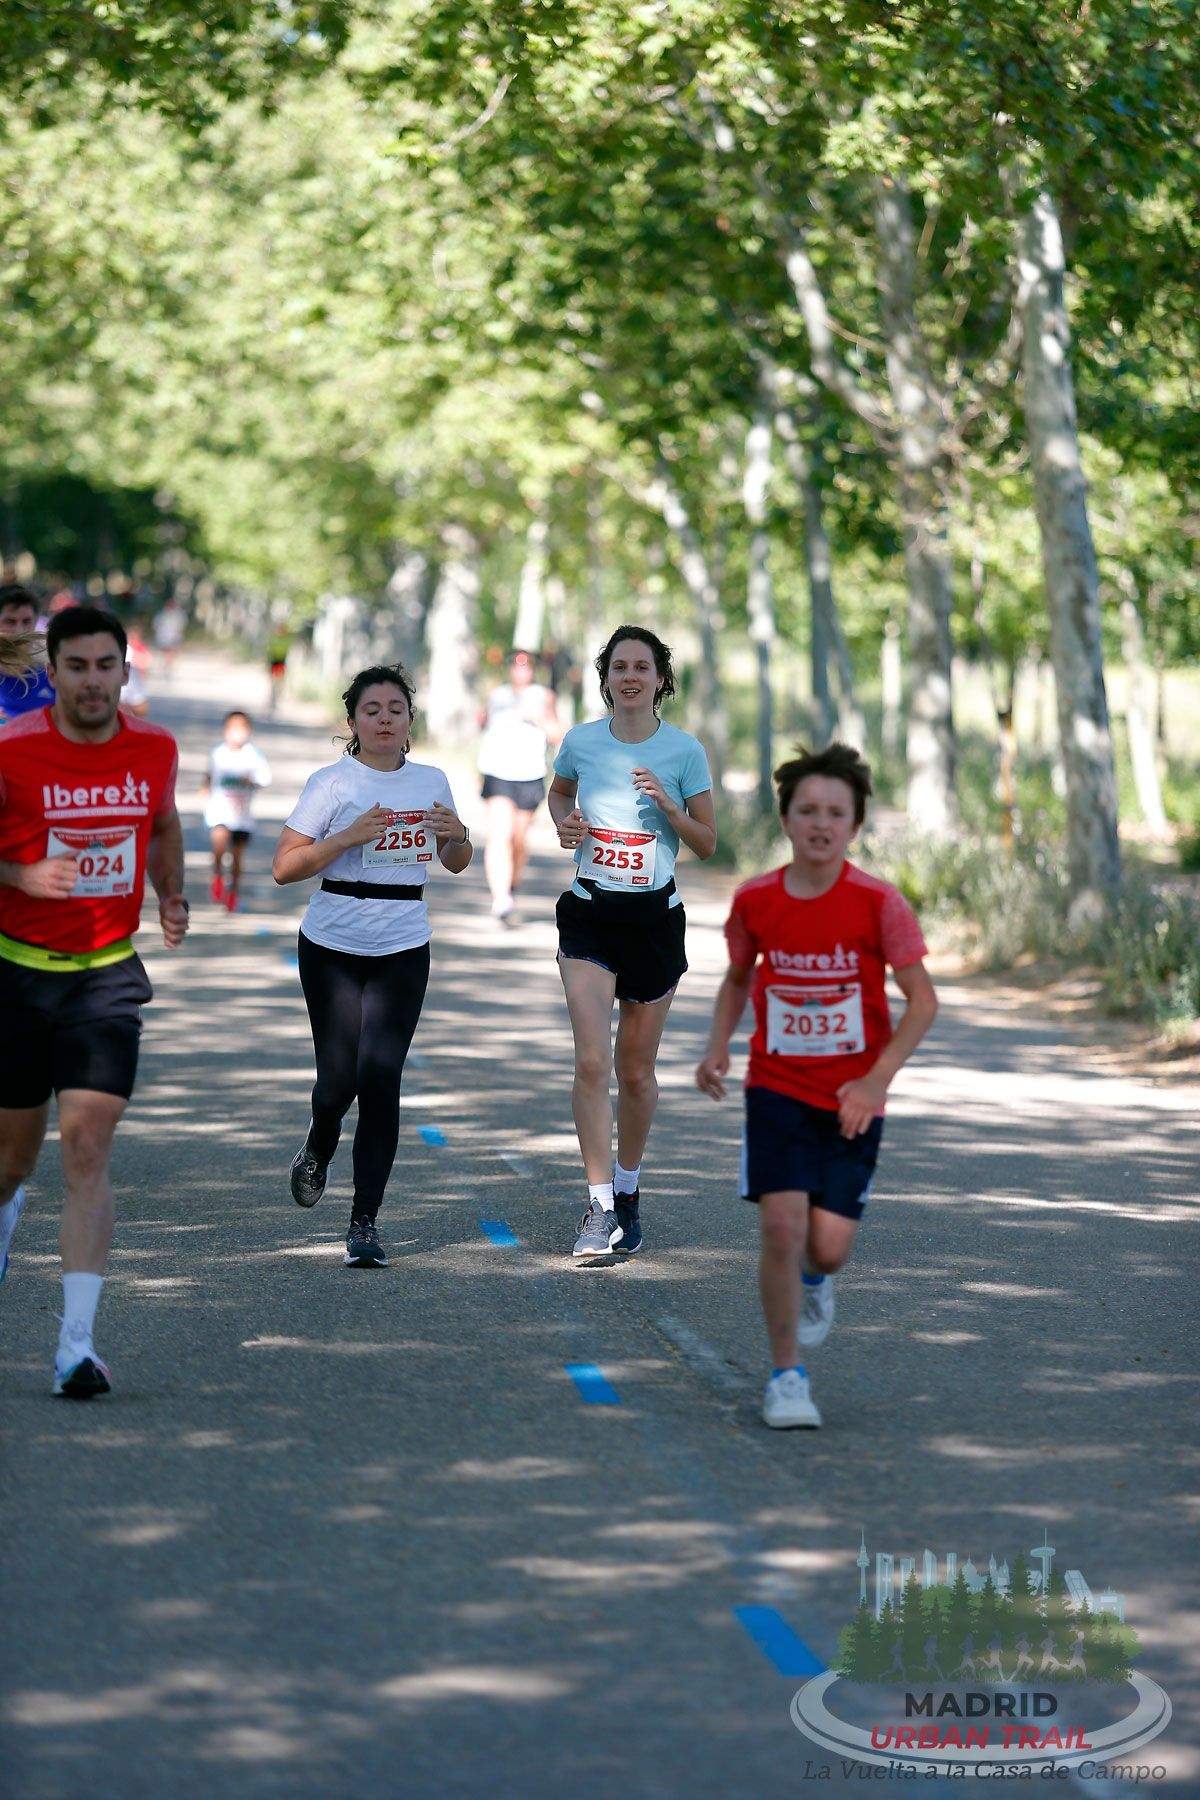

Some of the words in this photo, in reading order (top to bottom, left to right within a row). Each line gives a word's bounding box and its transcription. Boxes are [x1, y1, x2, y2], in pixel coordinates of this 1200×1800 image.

[42, 774, 150, 809] Iberext
[375, 829, 426, 851] 2256
[73, 854, 124, 877] 024
[592, 847, 644, 870] 2253
[783, 1013, 848, 1036] 2032
